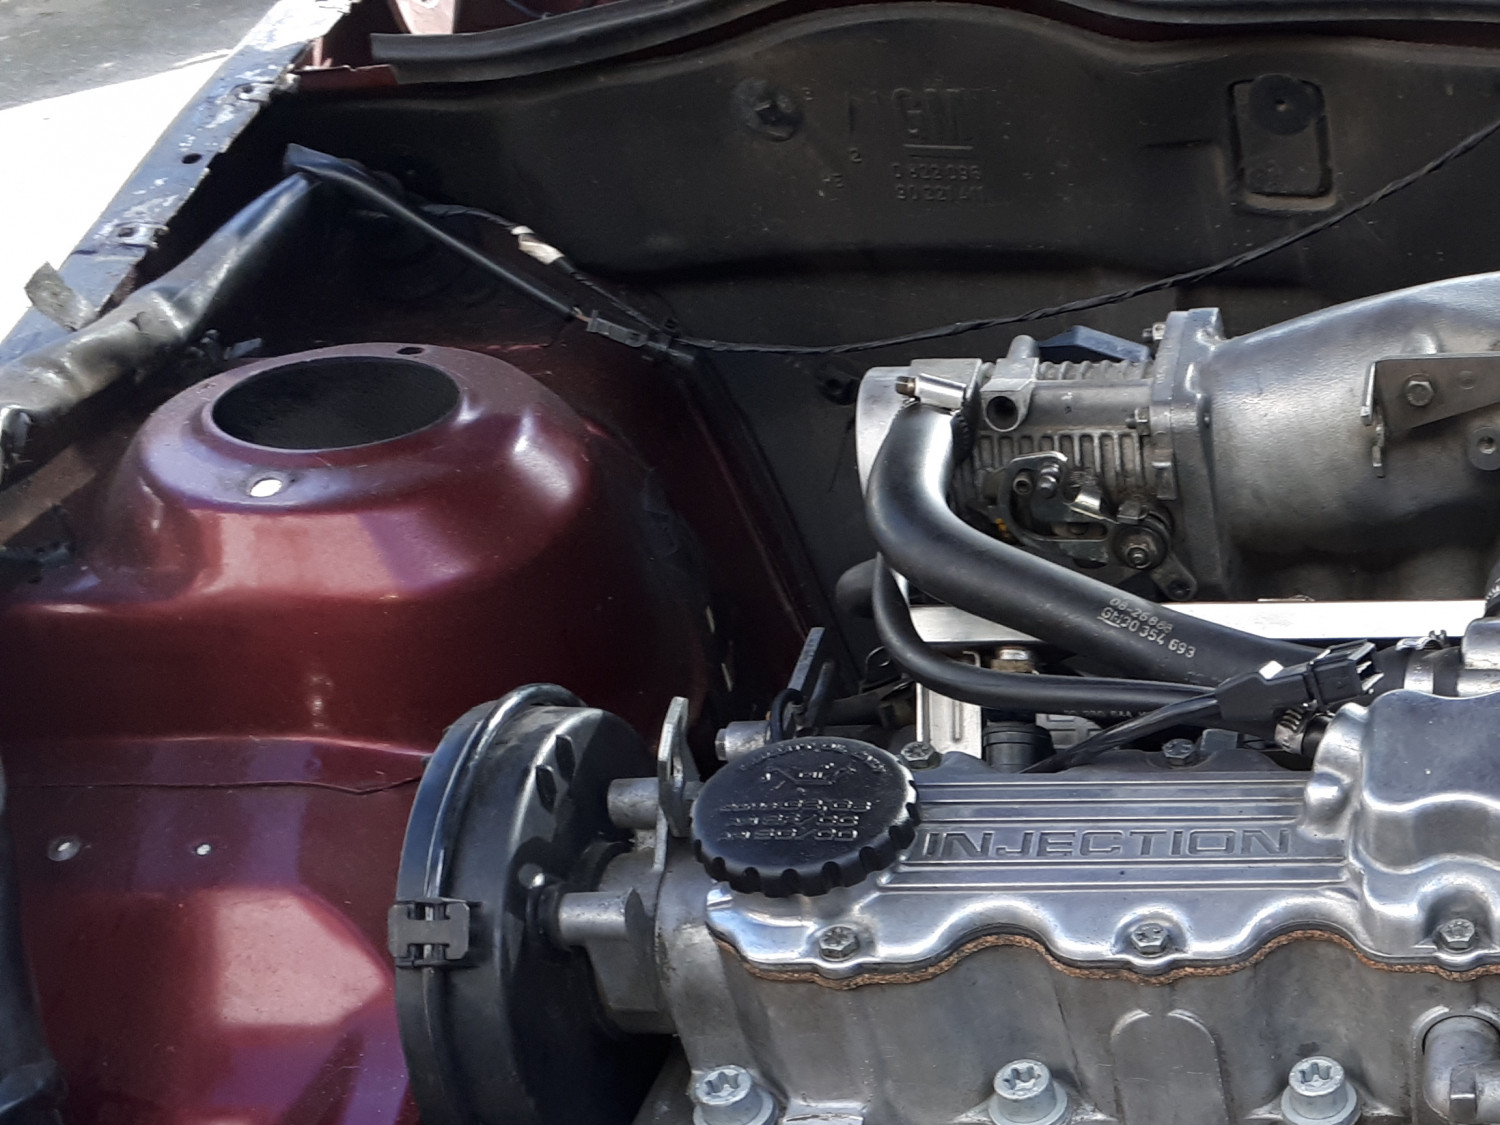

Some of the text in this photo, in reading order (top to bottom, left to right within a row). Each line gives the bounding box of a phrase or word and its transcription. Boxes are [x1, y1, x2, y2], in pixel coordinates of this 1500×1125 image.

[1139, 622, 1167, 646] 354
[1168, 637, 1197, 659] 693
[924, 828, 1292, 860] INJECTION
